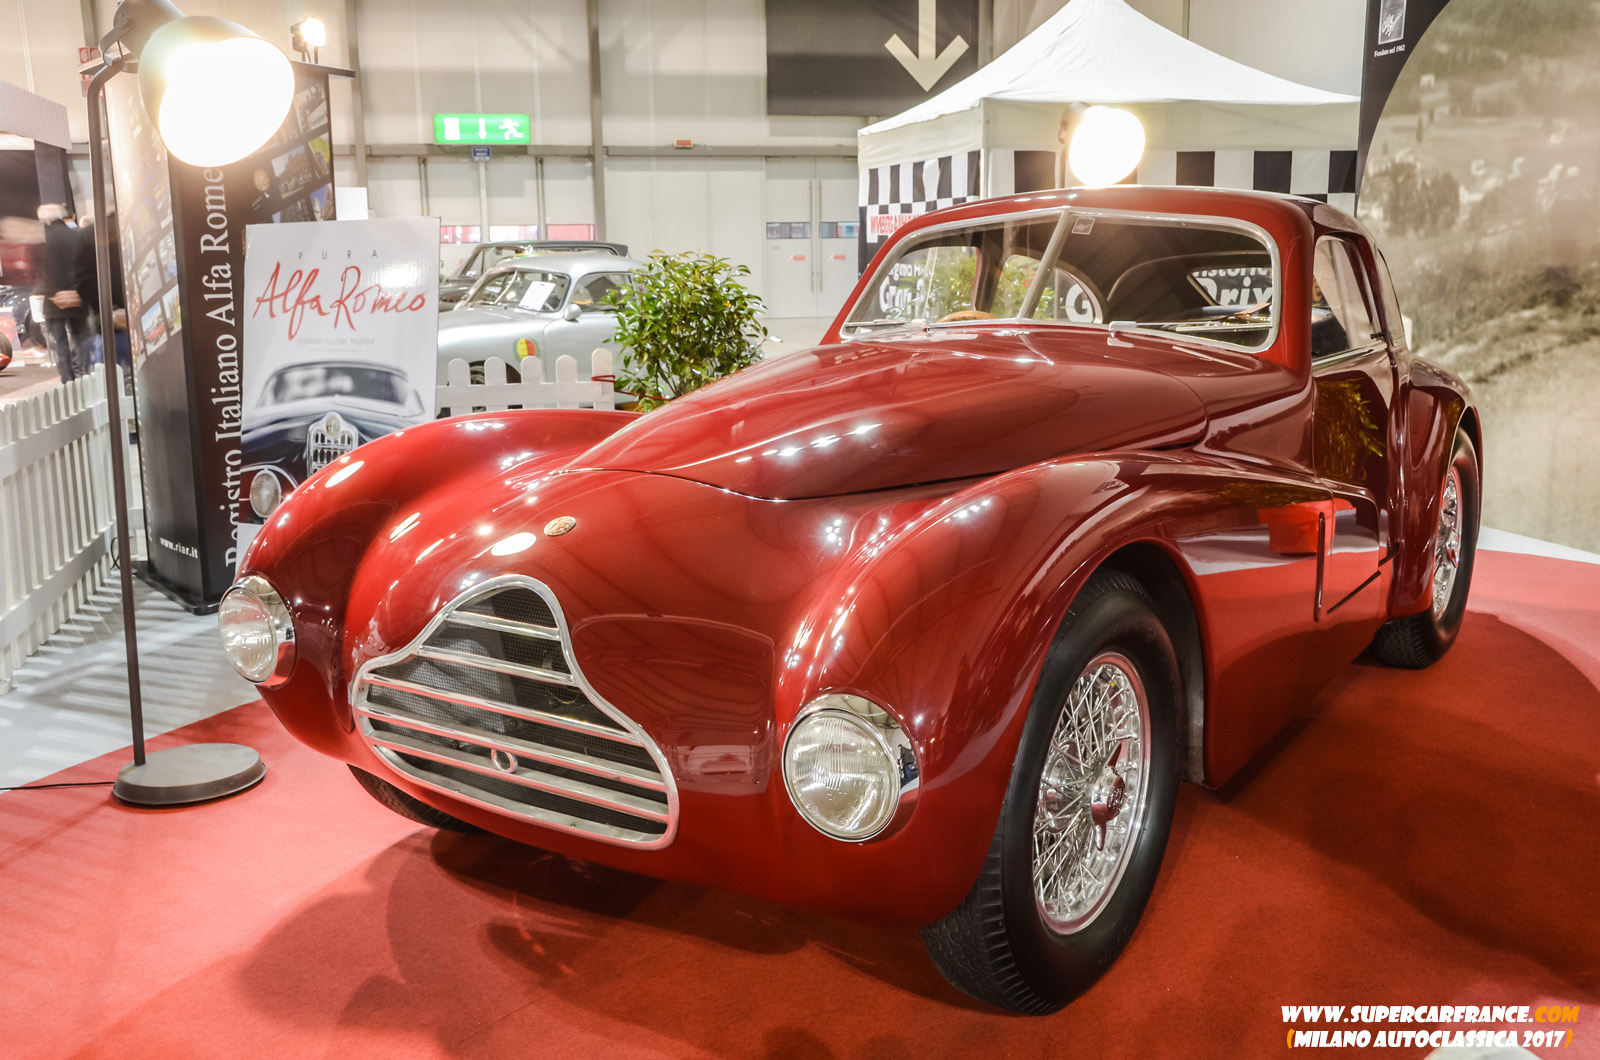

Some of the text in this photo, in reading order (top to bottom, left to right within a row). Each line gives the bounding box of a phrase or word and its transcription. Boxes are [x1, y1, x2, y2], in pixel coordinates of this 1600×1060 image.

[200, 167, 230, 254] Rome
[298, 249, 378, 261] PURA
[202, 262, 236, 327] Alfa
[252, 260, 431, 341] Alfa Romeo
[211, 333, 243, 443] Italiano
[159, 537, 199, 559] www.riar.it
